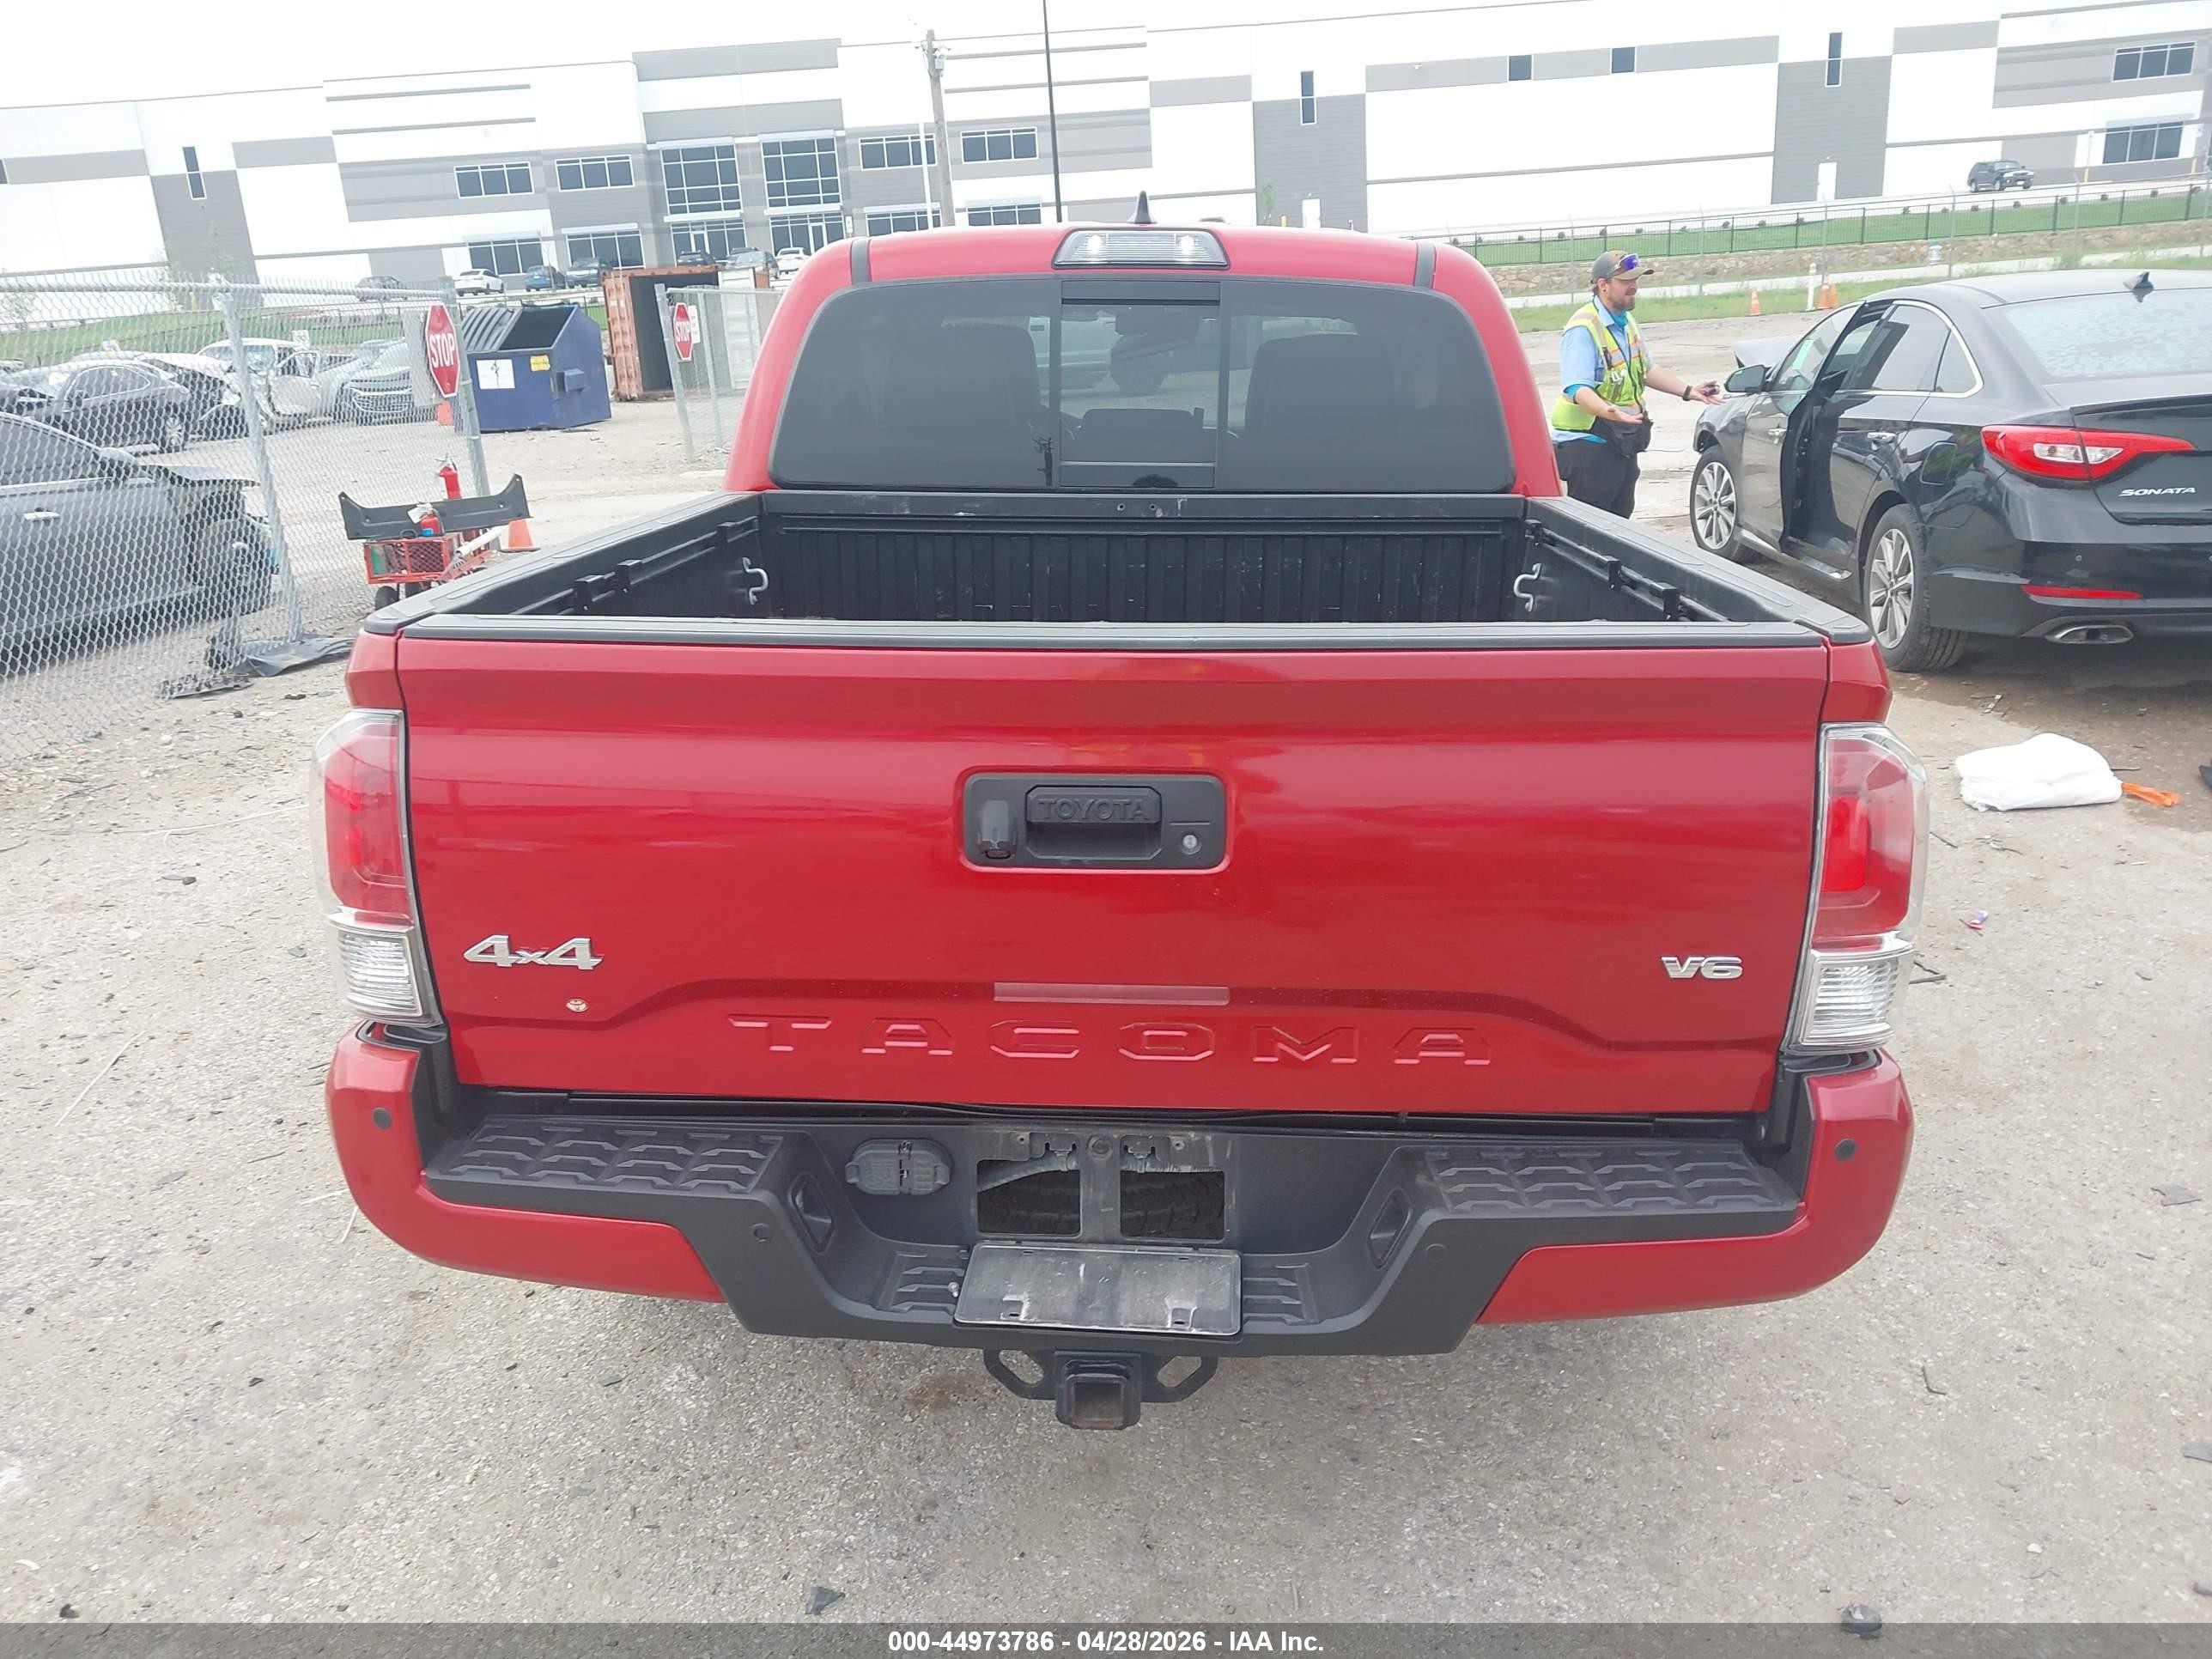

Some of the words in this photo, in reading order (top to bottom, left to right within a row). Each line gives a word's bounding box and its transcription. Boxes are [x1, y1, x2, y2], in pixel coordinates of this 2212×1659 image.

[676, 320, 690, 343] STOP
[429, 332, 455, 368] STOP
[2118, 487, 2196, 496] SONATA
[1037, 798, 1149, 820] TOYOTA
[463, 934, 603, 970] 4x4
[1661, 956, 1743, 979] V6
[728, 1014, 1492, 1065] TACOMA
